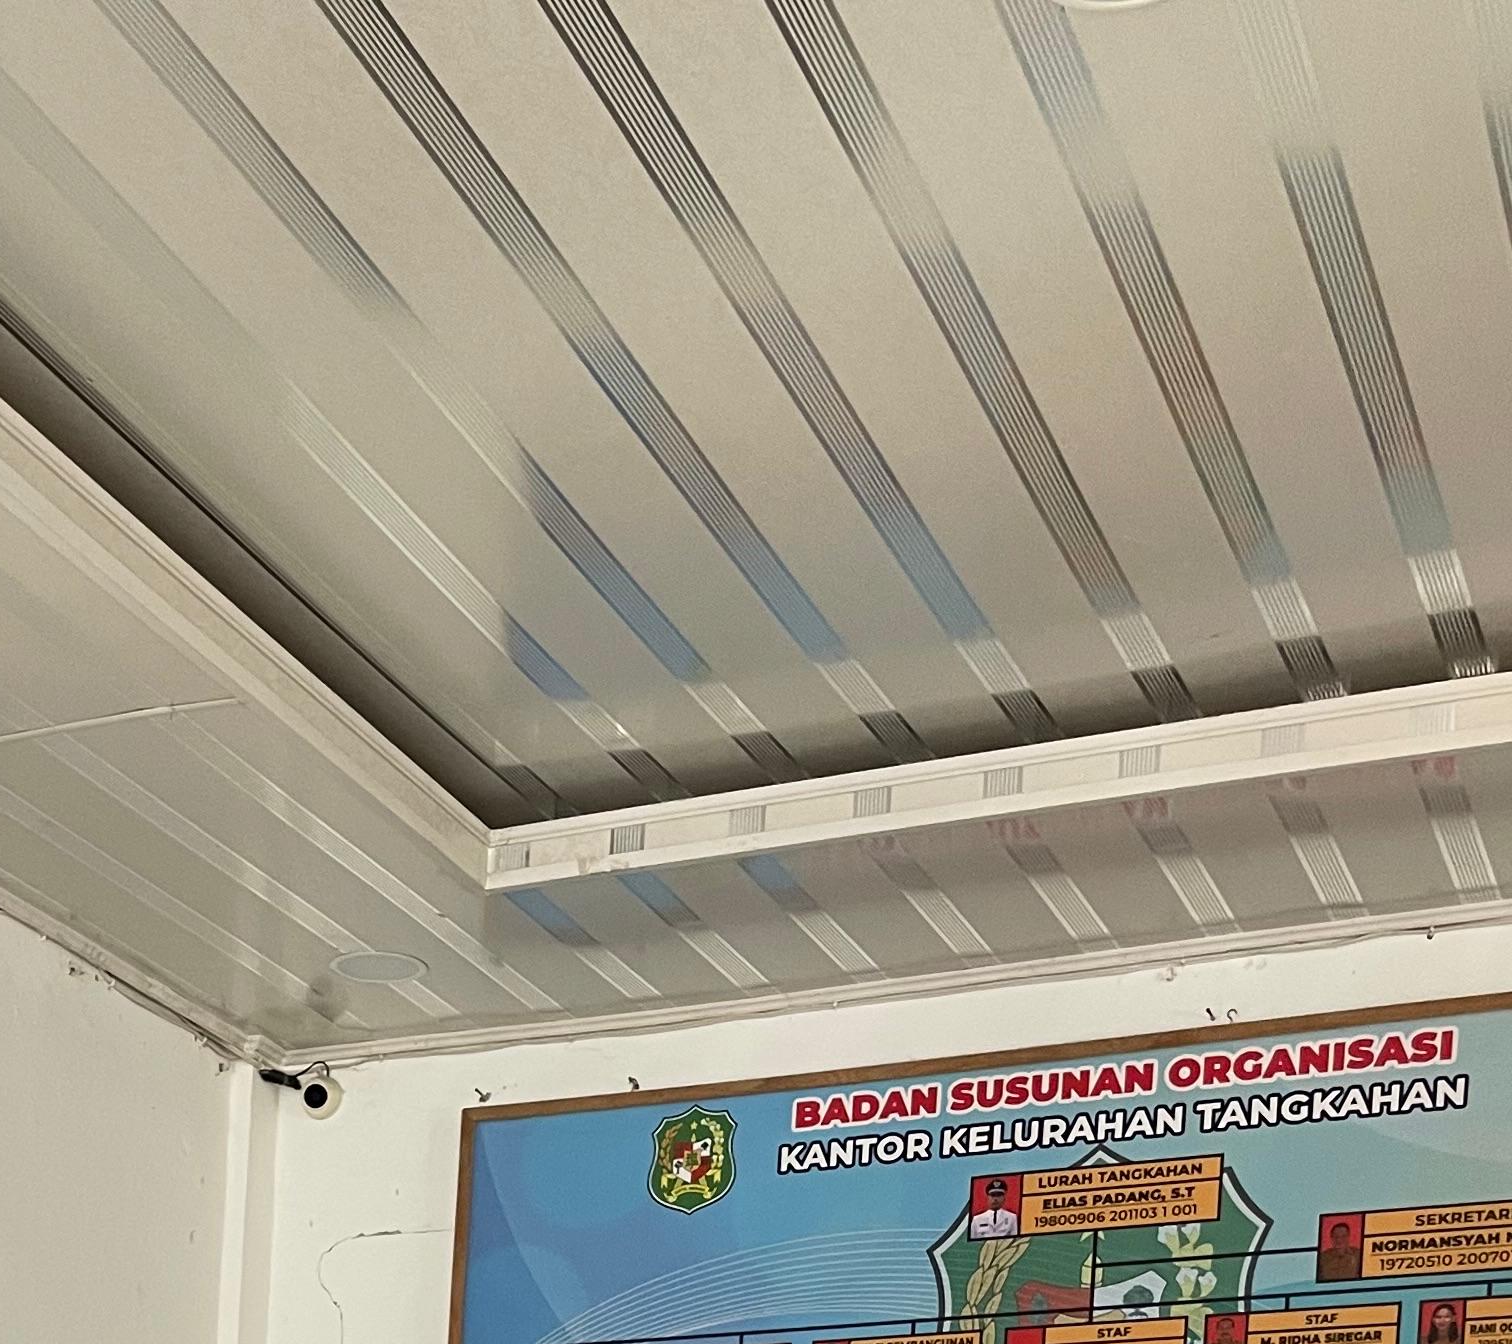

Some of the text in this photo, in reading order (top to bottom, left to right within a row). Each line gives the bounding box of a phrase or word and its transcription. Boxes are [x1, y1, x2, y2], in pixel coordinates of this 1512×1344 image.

[794, 1030, 1455, 1129] BADAN SUSUNAN ORGANISASI
[780, 1077, 1467, 1173] KANTOR KELURAHAN TANGKAHAN
[1038, 1162, 1203, 1189] LURAH TANGKAHAN
[1042, 1186, 1196, 1210] ELIAS PADANG, S.T
[1034, 1211, 1105, 1228] 19800906
[1109, 1206, 1157, 1223] 201103
[1172, 1204, 1197, 1217] 001
[1415, 1208, 1512, 1227] SEKRETAR
[1371, 1232, 1500, 1253] NORMANSYAH
[1380, 1250, 1512, 1271] 19720510 20070
[1305, 1313, 1338, 1325] STAF
[1097, 1327, 1132, 1338] STAF
[1324, 1330, 1382, 1343] SIREGAR
